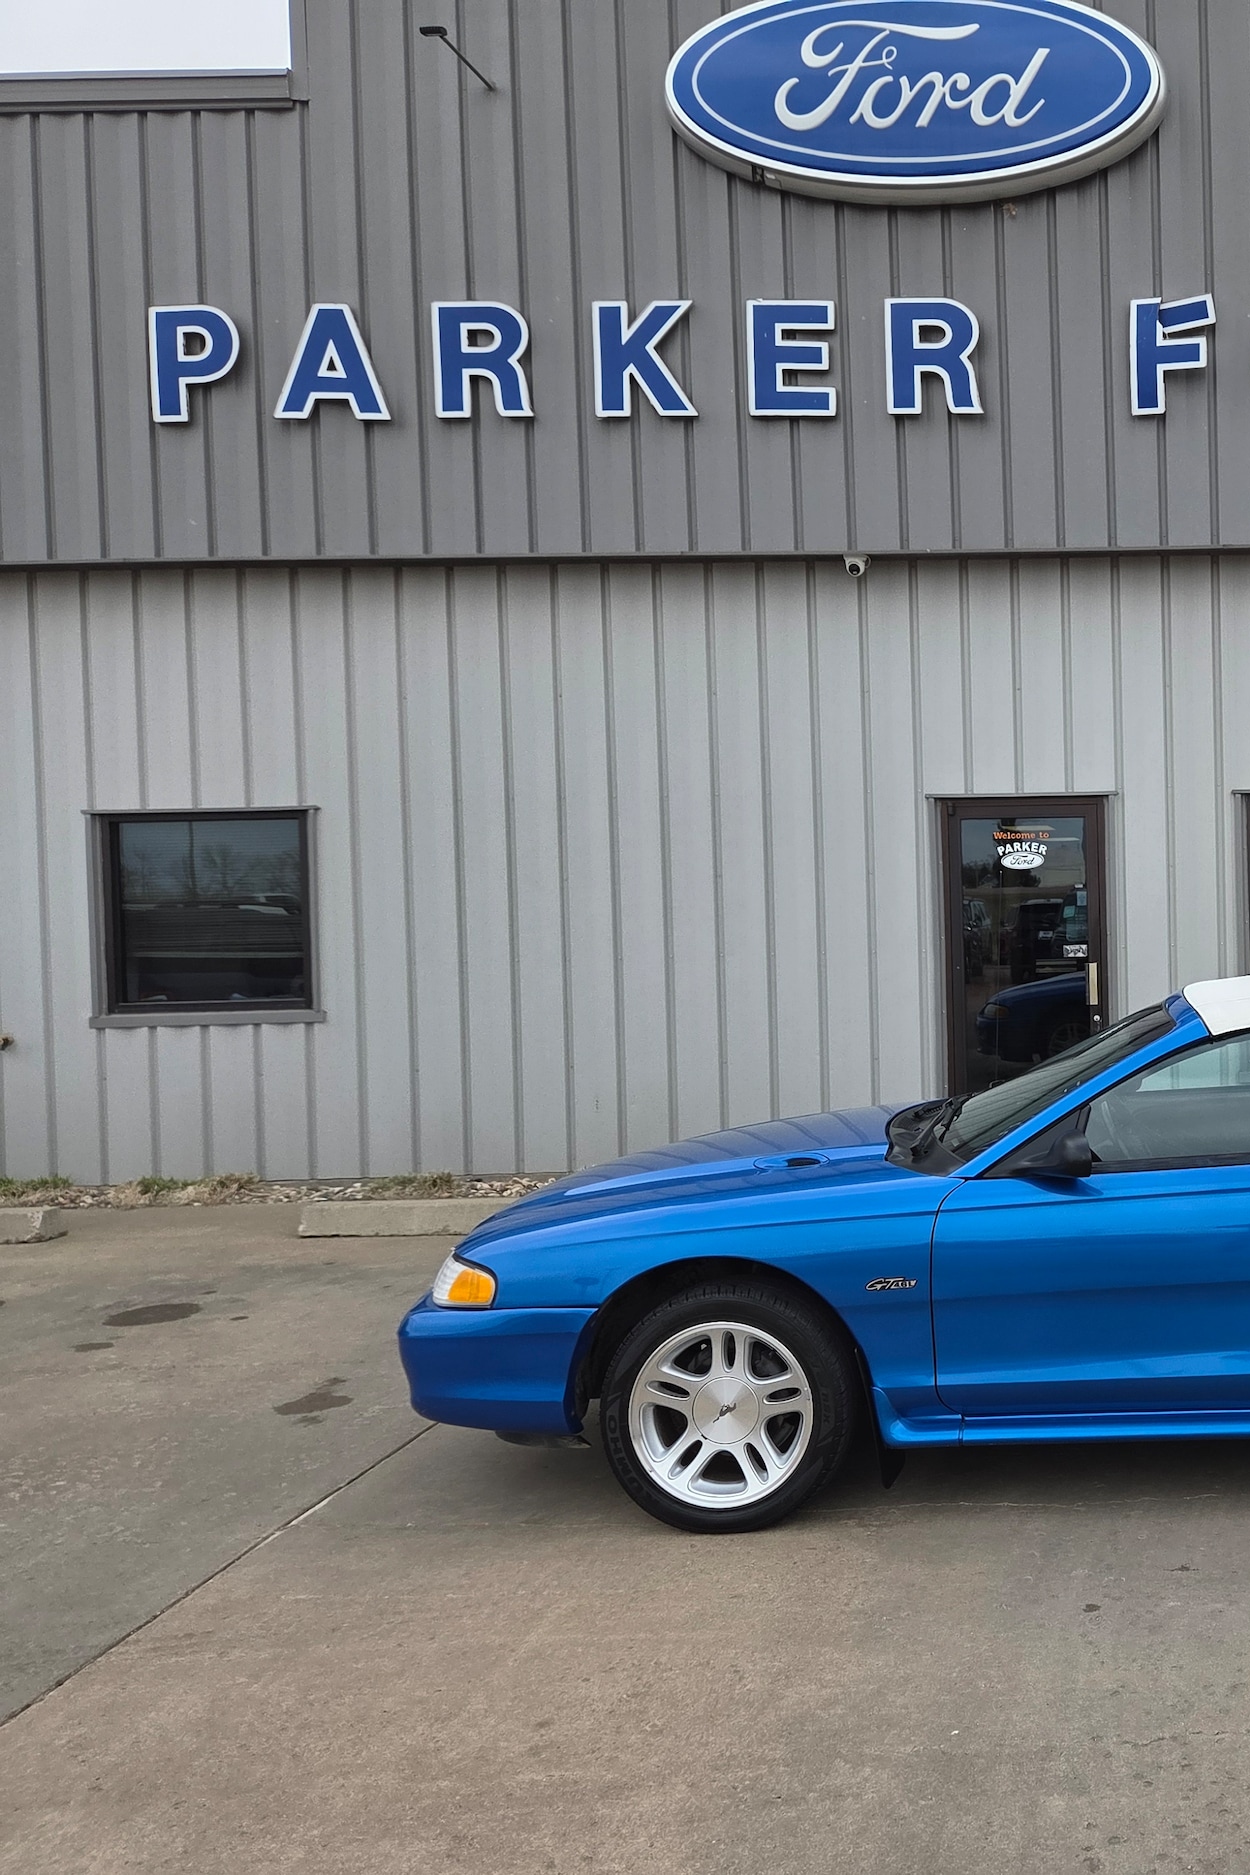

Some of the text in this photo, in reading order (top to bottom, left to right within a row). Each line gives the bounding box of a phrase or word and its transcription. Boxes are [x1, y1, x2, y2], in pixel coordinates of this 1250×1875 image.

[774, 20, 1050, 131] Ford
[148, 297, 984, 423] PARKER
[997, 842, 1047, 856] PARKER
[1010, 855, 1035, 865] Ford
